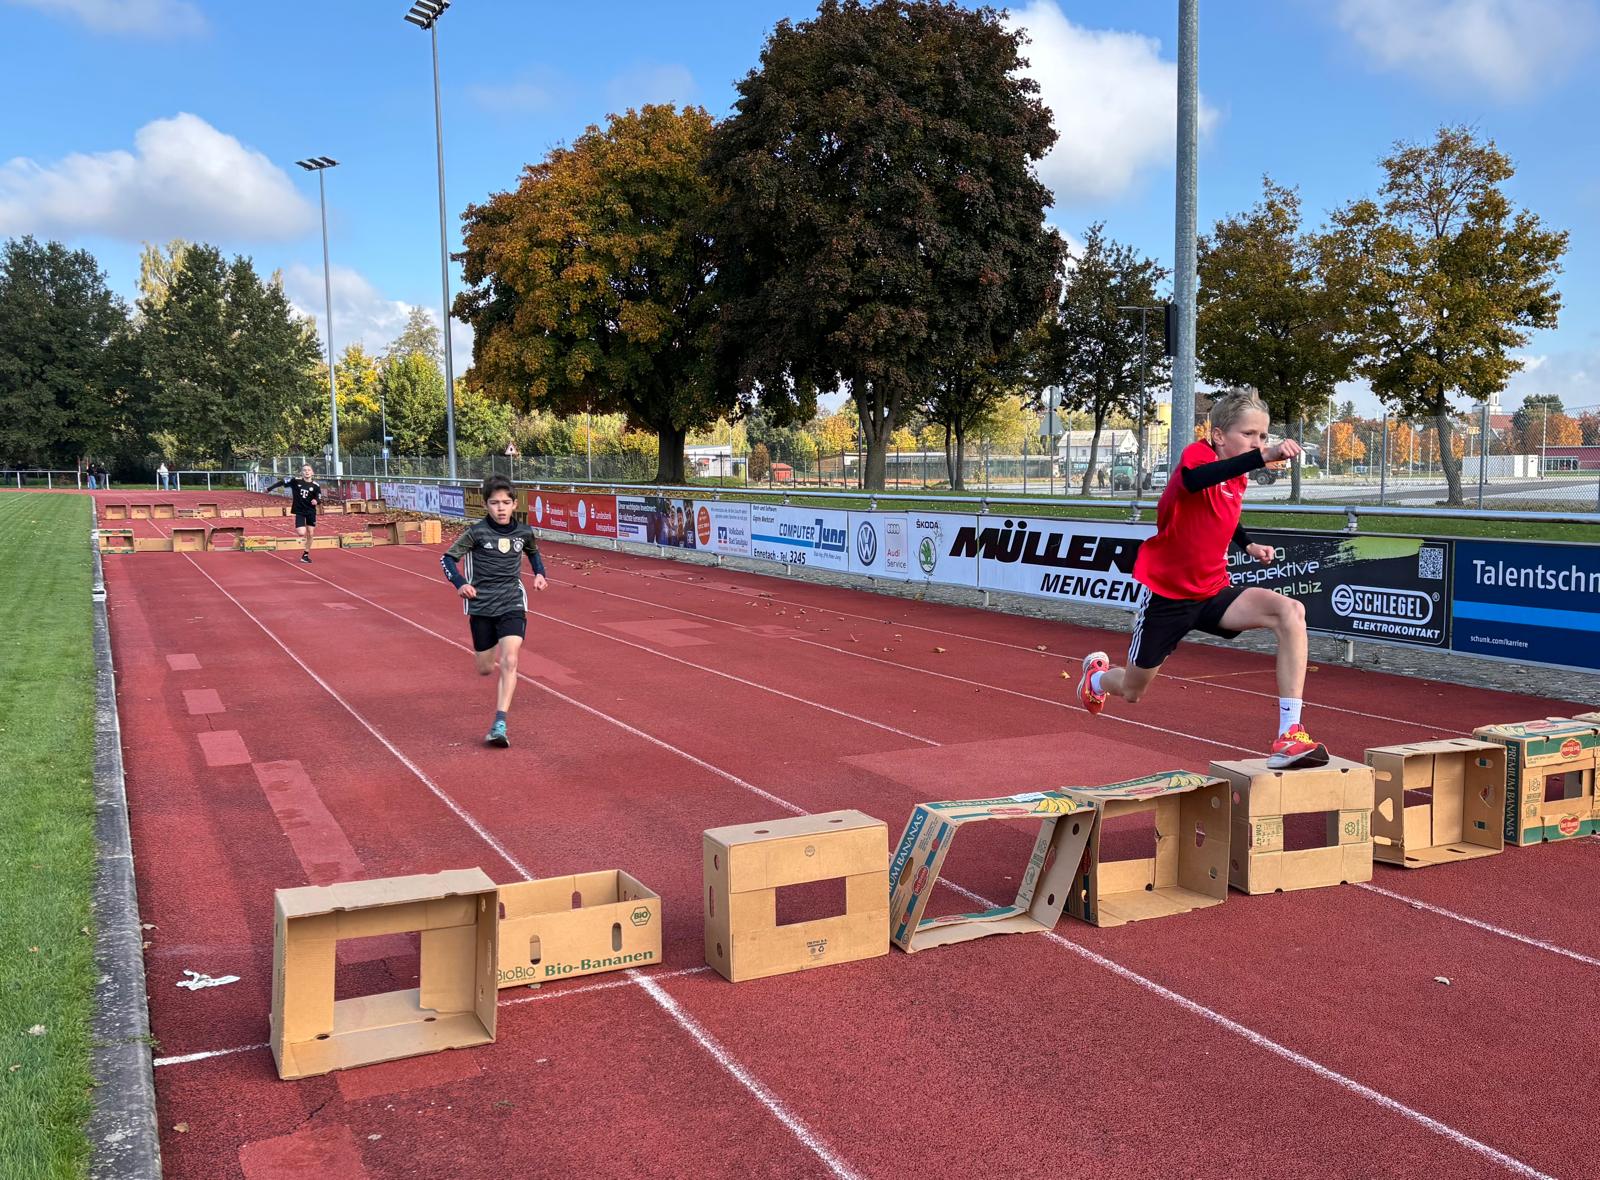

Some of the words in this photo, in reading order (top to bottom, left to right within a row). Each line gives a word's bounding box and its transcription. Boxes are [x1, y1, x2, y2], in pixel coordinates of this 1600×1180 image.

[779, 523, 815, 540] COMPUTER
[916, 518, 939, 529] ŠKODA
[754, 548, 776, 560] Ennetach
[789, 550, 806, 565] 3245
[887, 548, 901, 558] Audi
[948, 519, 1145, 574] MÜLLER
[887, 560, 907, 569] Service
[1040, 573, 1142, 603] MENGEN
[1355, 592, 1423, 618] SCHLEGEL
[1352, 620, 1441, 639] ELEKTROKONTAKT
[1470, 634, 1529, 648] schunk.com/karriere
[1507, 745, 1517, 789] PREMIUM
[1505, 791, 1516, 837] BANANAS
[896, 814, 924, 866] BANANAS
[544, 950, 654, 977] Bio-Bananen
